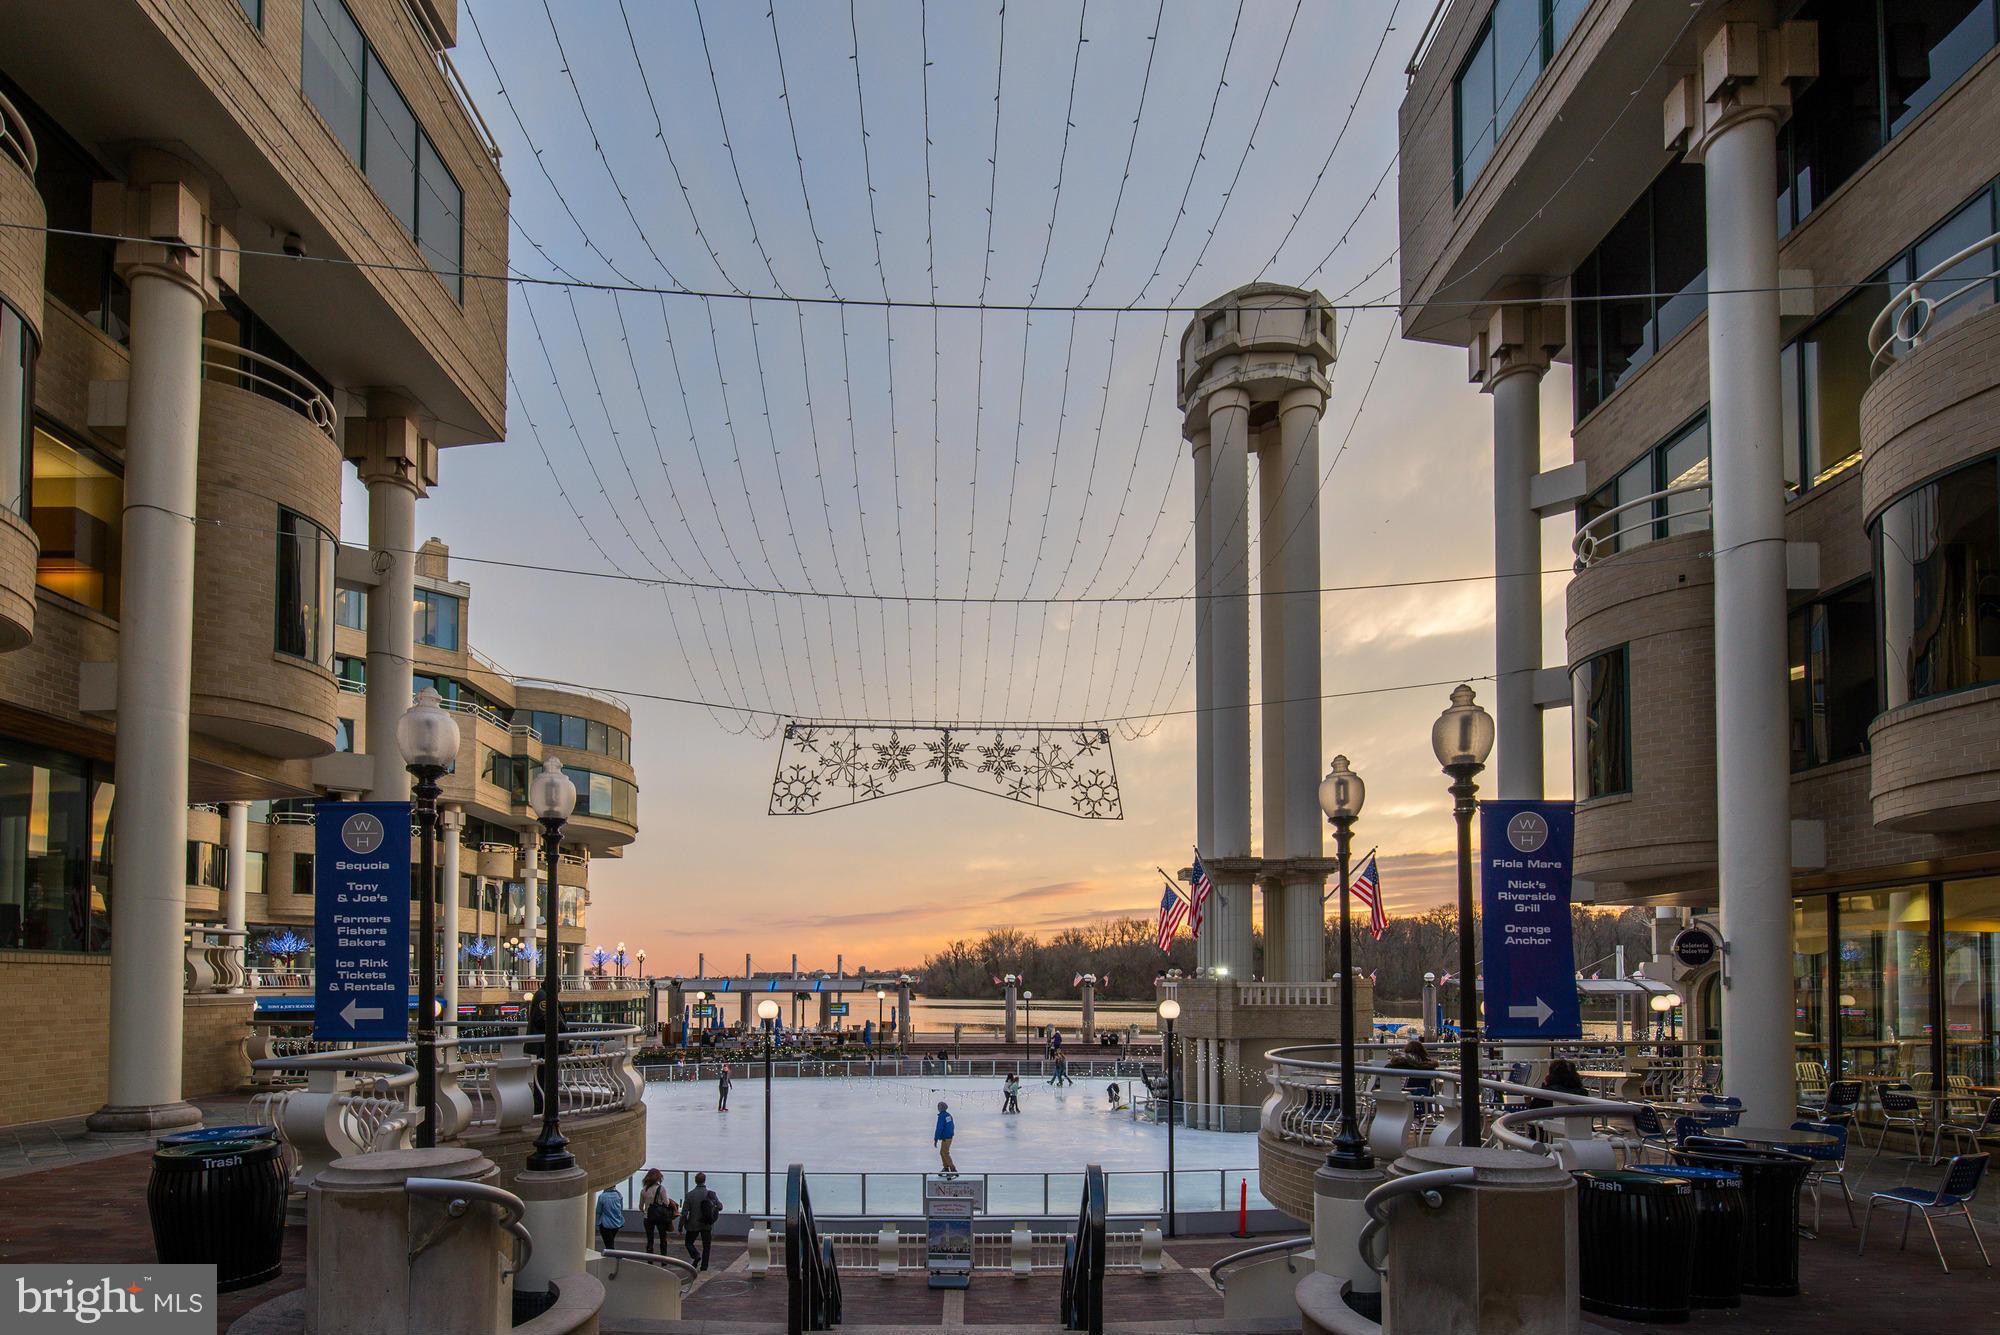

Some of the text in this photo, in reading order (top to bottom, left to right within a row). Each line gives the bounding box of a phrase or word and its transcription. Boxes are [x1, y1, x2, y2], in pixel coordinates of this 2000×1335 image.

[353, 820, 372, 832] W
[1519, 819, 1536, 830] W
[356, 837, 369, 848] H
[1522, 836, 1533, 846] H
[335, 861, 390, 872] Sequoia
[1493, 859, 1562, 869] Fiola Mare
[346, 882, 379, 894] Tony
[1508, 880, 1547, 890] Nick's
[337, 893, 388, 903] & Joe's
[1498, 892, 1557, 902] Riverside
[1515, 903, 1541, 913] Grill
[333, 914, 392, 924] Farmers
[337, 926, 388, 935] Fishers
[1504, 924, 1552, 936] Orange
[338, 938, 387, 947] Bakers
[1504, 936, 1553, 946] Anchor
[335, 958, 389, 968] Ice Rink
[337, 971, 387, 980] Tickets
[328, 982, 396, 992] & Rentals
[202, 1155, 243, 1169] Trash
[1587, 1178, 1622, 1193] Trash
[1674, 1184, 1692, 1196] Tras
